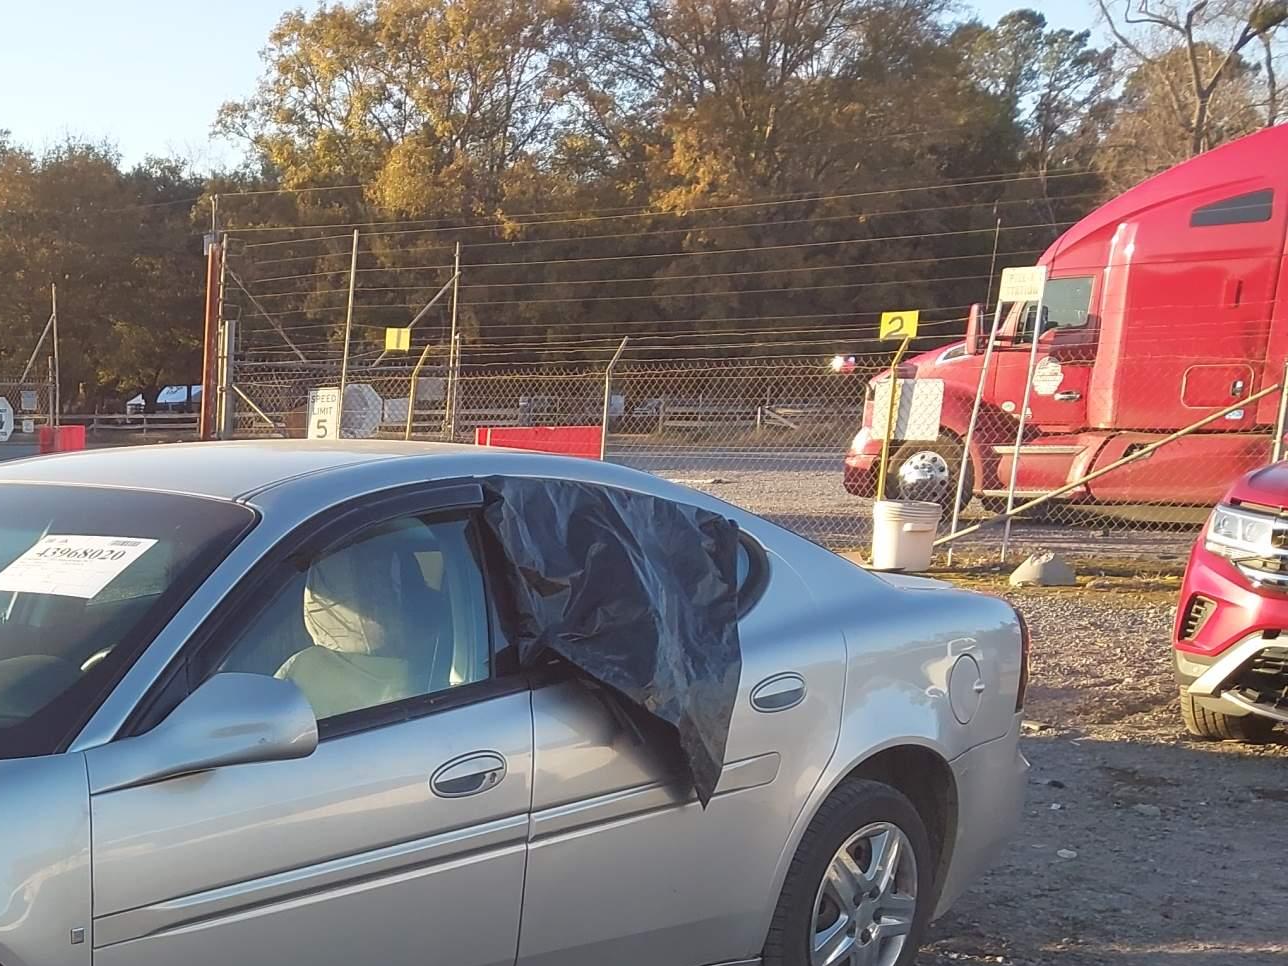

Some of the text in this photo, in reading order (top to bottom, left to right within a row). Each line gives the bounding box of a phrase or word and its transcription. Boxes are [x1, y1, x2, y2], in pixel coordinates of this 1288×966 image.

[884, 315, 905, 338] 2
[310, 394, 337, 403] SPEED
[312, 406, 333, 416] LIMIT
[316, 418, 328, 439] 5
[35, 547, 127, 561] 43968020
